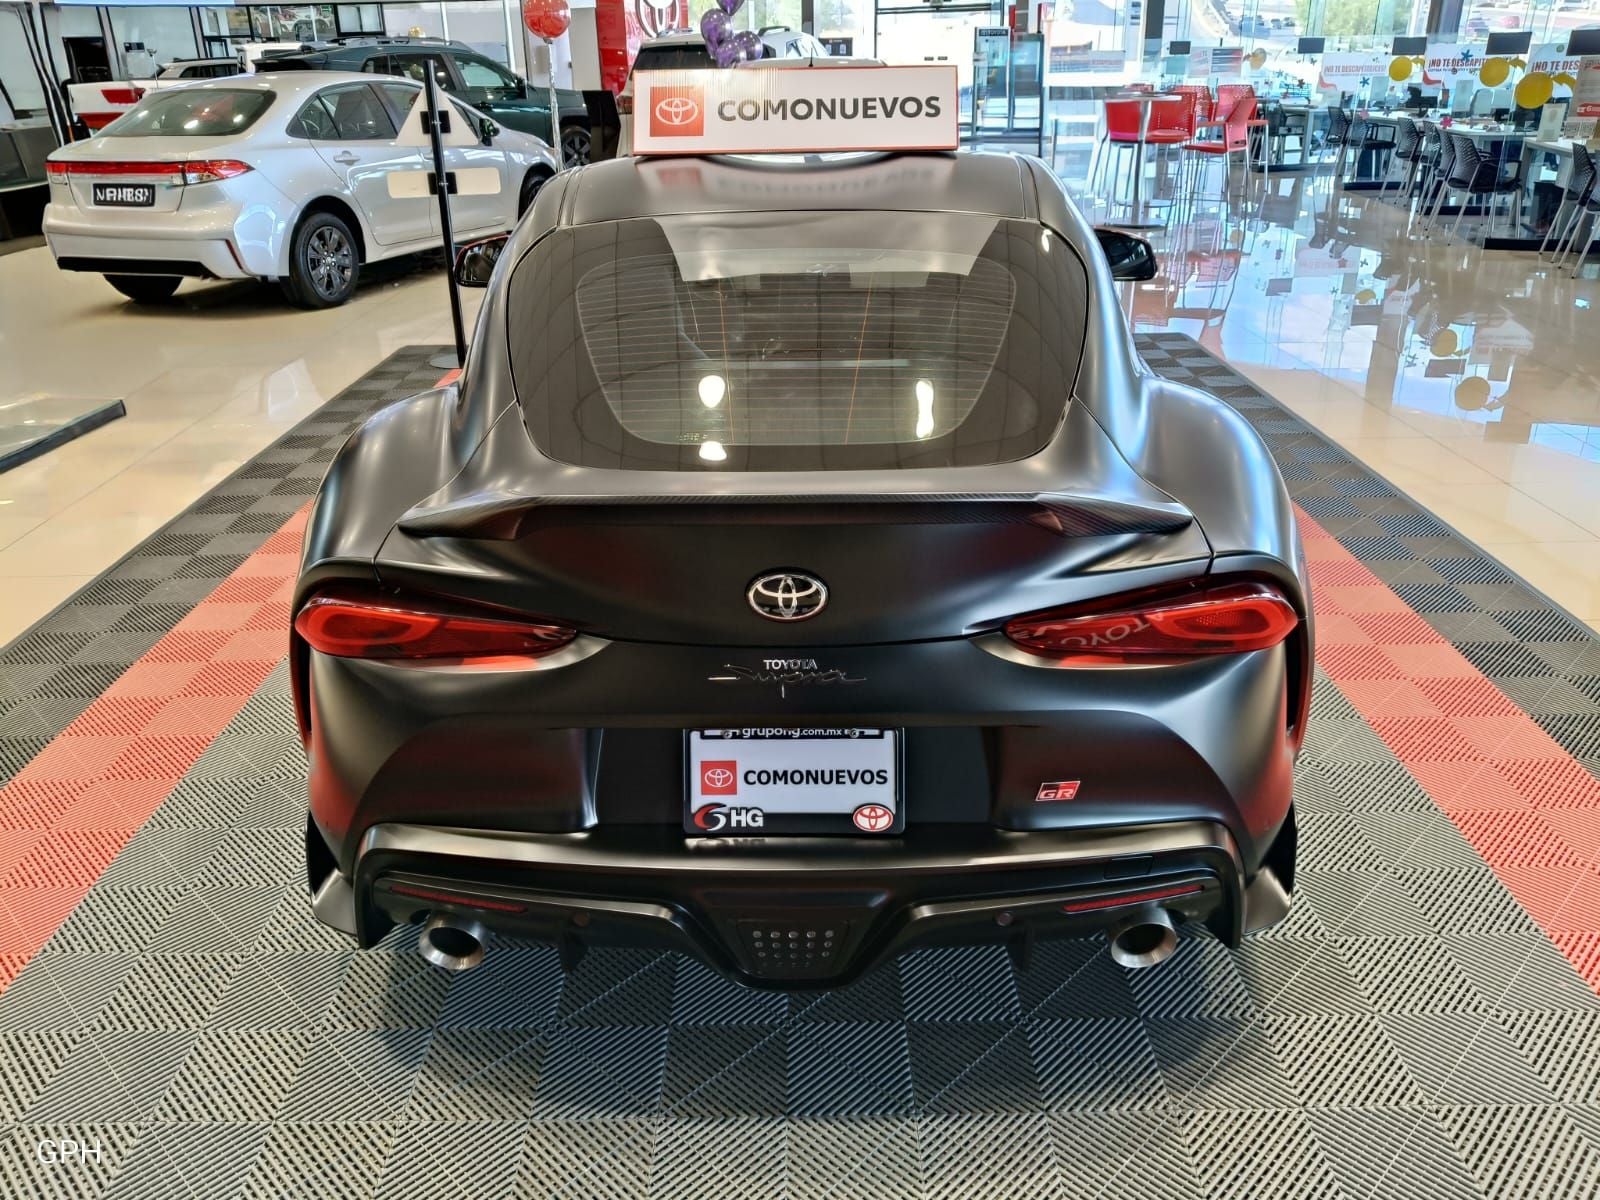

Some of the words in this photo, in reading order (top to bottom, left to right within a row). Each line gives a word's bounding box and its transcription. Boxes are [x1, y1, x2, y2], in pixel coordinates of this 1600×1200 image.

[1550, 61, 1561, 71] TE
[718, 95, 942, 121] COMONUEVOS
[763, 659, 818, 670] TOYOTA
[708, 664, 867, 698] Supra
[743, 769, 888, 786] COMONUEVOS
[1039, 789, 1075, 799] GR
[730, 808, 764, 828] HG
